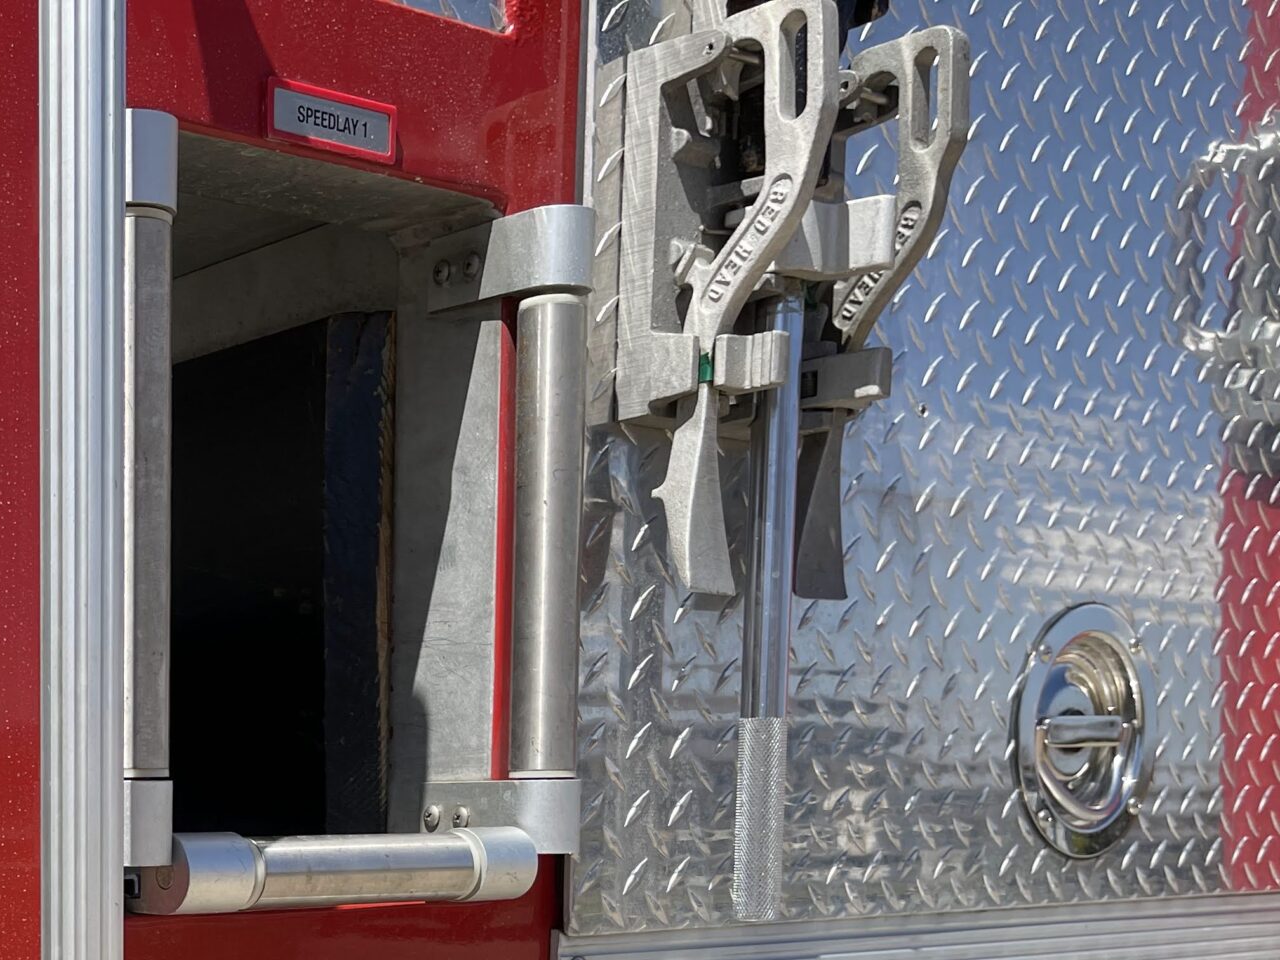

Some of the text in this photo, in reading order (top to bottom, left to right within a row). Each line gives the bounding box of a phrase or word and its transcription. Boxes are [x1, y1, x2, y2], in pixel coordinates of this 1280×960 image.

[297, 105, 368, 138] SPEEDLAY 1
[708, 190, 788, 303] RED HEAD
